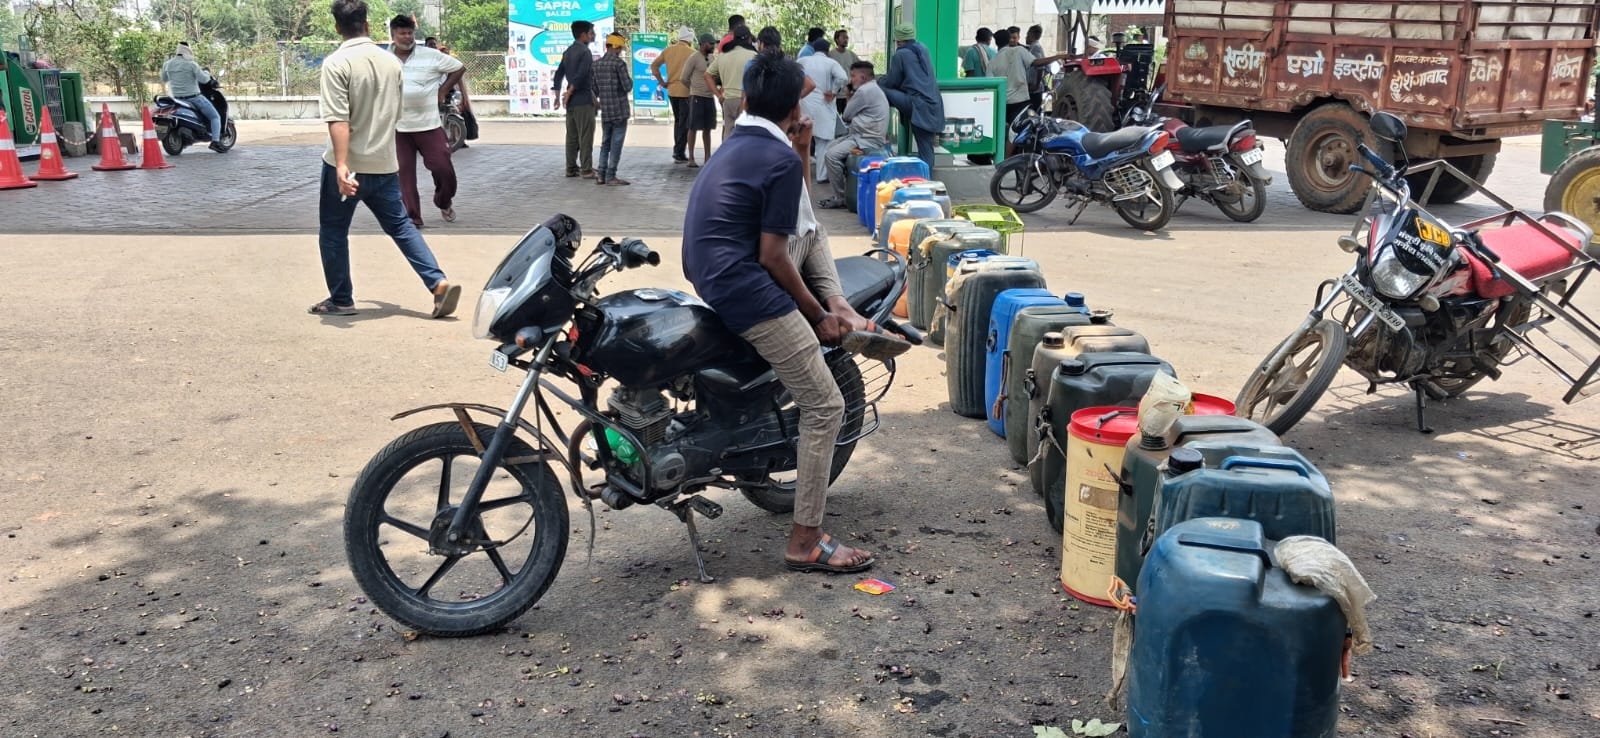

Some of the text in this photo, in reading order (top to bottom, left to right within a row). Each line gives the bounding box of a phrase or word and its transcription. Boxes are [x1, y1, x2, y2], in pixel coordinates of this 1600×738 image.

[535, 0, 580, 10] SAPRA
[1287, 49, 1325, 77] एग्रो
[22, 90, 34, 123] Castrol
[1420, 222, 1449, 245] JCB
